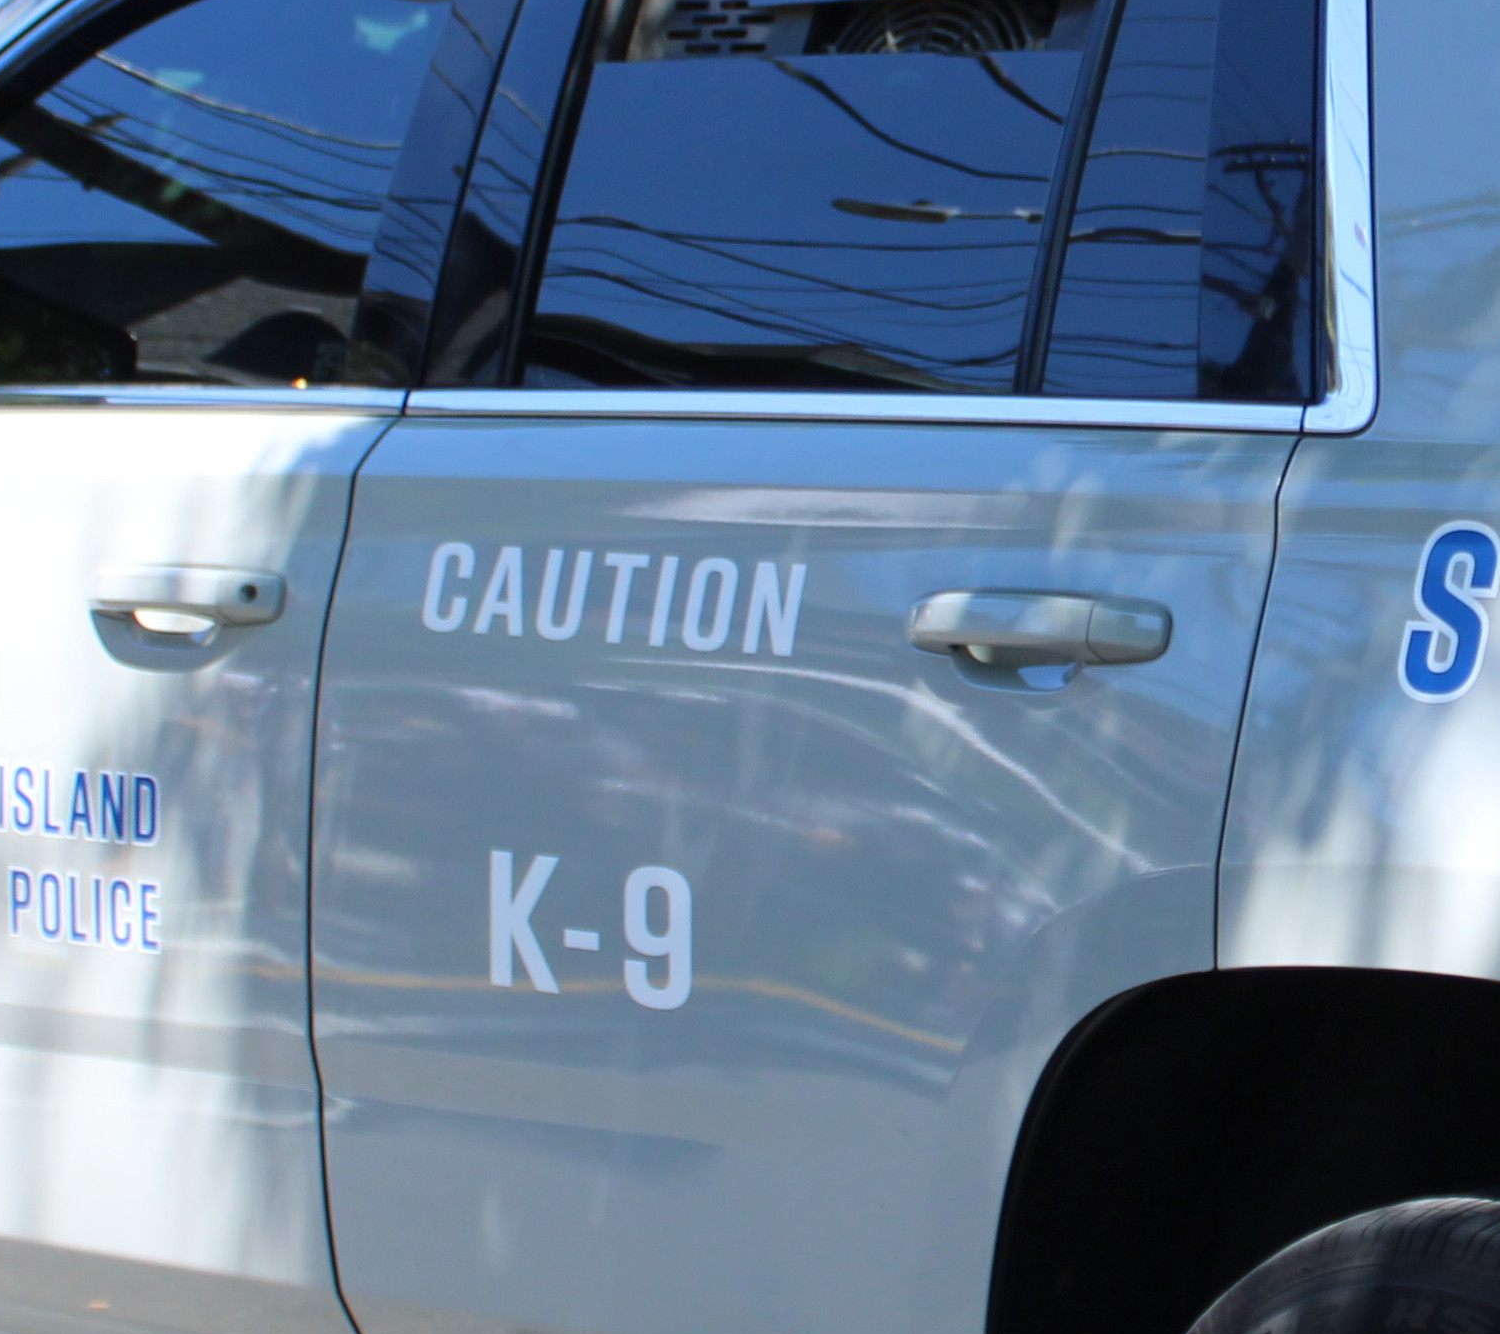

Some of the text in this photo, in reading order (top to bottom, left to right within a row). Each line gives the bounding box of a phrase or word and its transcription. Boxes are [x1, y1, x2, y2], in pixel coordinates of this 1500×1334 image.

[421, 541, 808, 657] CAUTION
[8, 868, 162, 952] POLICE
[489, 849, 693, 1011] K-9
